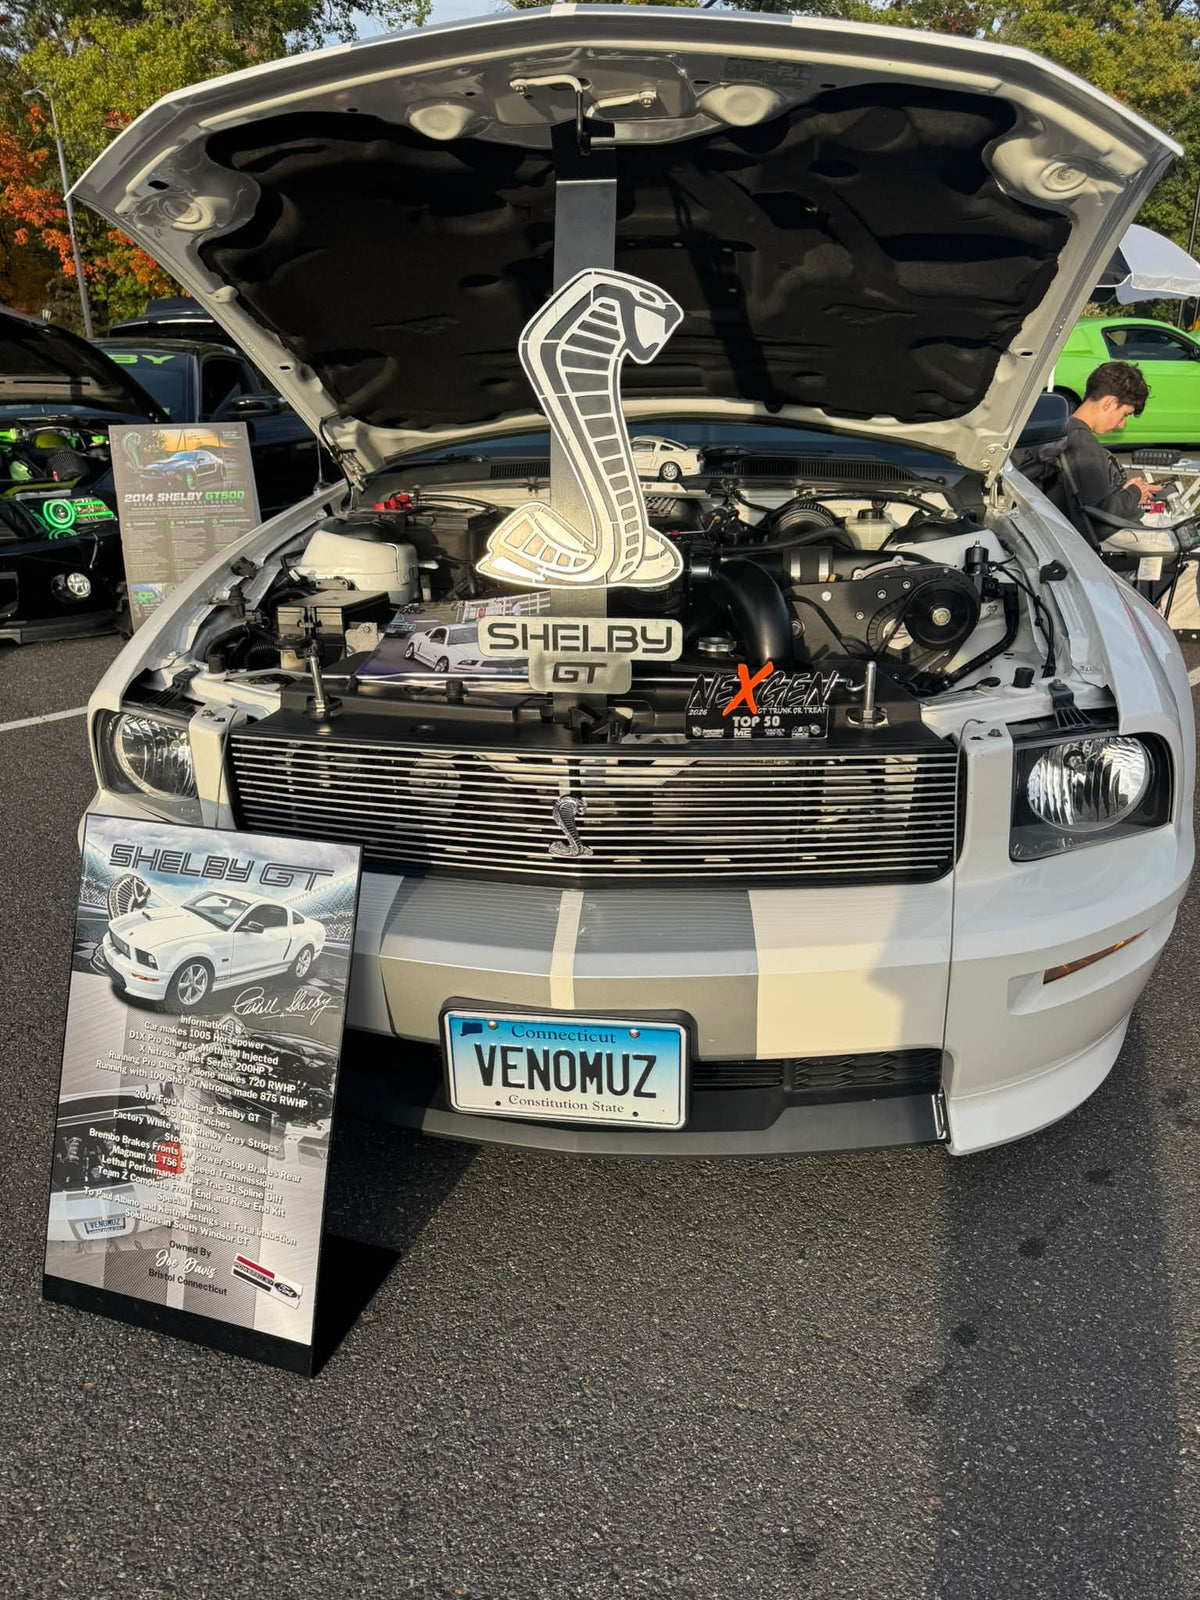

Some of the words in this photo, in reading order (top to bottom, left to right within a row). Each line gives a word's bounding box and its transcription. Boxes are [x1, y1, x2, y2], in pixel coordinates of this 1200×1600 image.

[124, 493, 154, 503] 2014
[157, 492, 203, 502] SHELBY
[205, 490, 245, 501] GT500
[487, 622, 673, 653] SHELBY
[552, 661, 607, 684] GT
[733, 716, 760, 727] TOP
[764, 716, 780, 727] 50
[109, 843, 255, 883] SHELBY
[259, 862, 335, 891] GT
[144, 1021, 158, 1031] Car
[160, 1025, 187, 1036] makes
[189, 1030, 211, 1040] 1005
[213, 1031, 264, 1049] Horsepower
[181, 1015, 228, 1032] Information
[511, 1025, 616, 1044] Connecticut
[148, 1033, 162, 1044] Pro
[199, 1043, 240, 1058] Methanol
[242, 1050, 279, 1065] Injected
[148, 1046, 176, 1059] Nitrous
[178, 1051, 205, 1064] Outlet
[207, 1057, 233, 1069] Series
[96, 1059, 127, 1075] Running
[129, 1067, 147, 1077] with
[149, 1070, 165, 1081] 100
[167, 1074, 187, 1086] Shot
[188, 1079, 198, 1087] of
[234, 1087, 258, 1099] made
[260, 1092, 277, 1103] 875
[279, 1096, 308, 1109] RWHP
[108, 1050, 140, 1065] Running
[142, 1057, 156, 1067] Pro
[159, 1060, 190, 1074] Charger
[192, 1067, 216, 1079] alone
[217, 1072, 246, 1084] makes
[248, 1076, 266, 1088] 720
[267, 1080, 296, 1093] RWHP
[474, 1043, 657, 1098] VENOMUZ
[179, 1098, 214, 1115] Mustang
[217, 1105, 246, 1121] Shelby
[248, 1112, 260, 1122] GT
[508, 1094, 588, 1111] Constitution
[592, 1101, 624, 1113] State
[113, 1109, 144, 1124] Factory
[145, 1116, 171, 1129] White
[174, 1123, 193, 1134] with
[194, 1126, 223, 1142] Shelby
[225, 1133, 246, 1146] Grey
[247, 1138, 279, 1153] Stripes
[160, 1108, 176, 1118] 285
[202, 1117, 231, 1130] Inches
[89, 1127, 120, 1142] Brembo
[121, 1135, 150, 1149] Brakes
[152, 1141, 179, 1155] Fronts
[195, 1152, 223, 1165] Power
[225, 1159, 245, 1171] Stop
[247, 1163, 278, 1178] Brakes
[280, 1170, 302, 1183] Rear
[164, 1132, 189, 1146] Stock
[191, 1136, 222, 1153] Interior
[101, 1154, 127, 1165] Lethal
[128, 1160, 181, 1180] Performance
[225, 1184, 237, 1194] 31
[238, 1186, 265, 1201] Spline
[266, 1192, 284, 1205] Diff
[112, 1145, 146, 1160] Magnum
[147, 1152, 159, 1163] XL
[161, 1155, 177, 1167] T56
[179, 1160, 186, 1169] 6
[189, 1163, 216, 1176] Speed
[219, 1168, 274, 1189] Transmission
[98, 1165, 120, 1178] Team
[121, 1170, 128, 1180] Z
[129, 1173, 169, 1190] Complete
[171, 1182, 193, 1196] Front
[195, 1188, 212, 1200] End
[213, 1193, 229, 1204] and
[231, 1197, 251, 1209] Rear
[253, 1202, 271, 1214] End
[272, 1207, 286, 1218] Kit
[157, 1191, 187, 1207] Special
[189, 1199, 220, 1214] Thanks
[84, 1186, 95, 1196] To
[96, 1189, 113, 1201] Paul
[114, 1194, 139, 1208] Albino
[142, 1201, 157, 1211] and
[158, 1205, 181, 1218] Keith
[182, 1211, 219, 1227] Hastings
[221, 1221, 231, 1230] at
[233, 1222, 256, 1236] Total
[256, 1229, 297, 1247] Induction
[163, 1219, 171, 1228] in
[173, 1220, 198, 1234] South
[200, 1227, 235, 1243] Windsor
[237, 1236, 250, 1246] CT
[169, 1240, 199, 1255] Owned
[200, 1247, 212, 1258] By
[183, 1257, 217, 1278] Davis
[149, 1268, 175, 1282] Bristol
[177, 1275, 228, 1296] Connecticut
